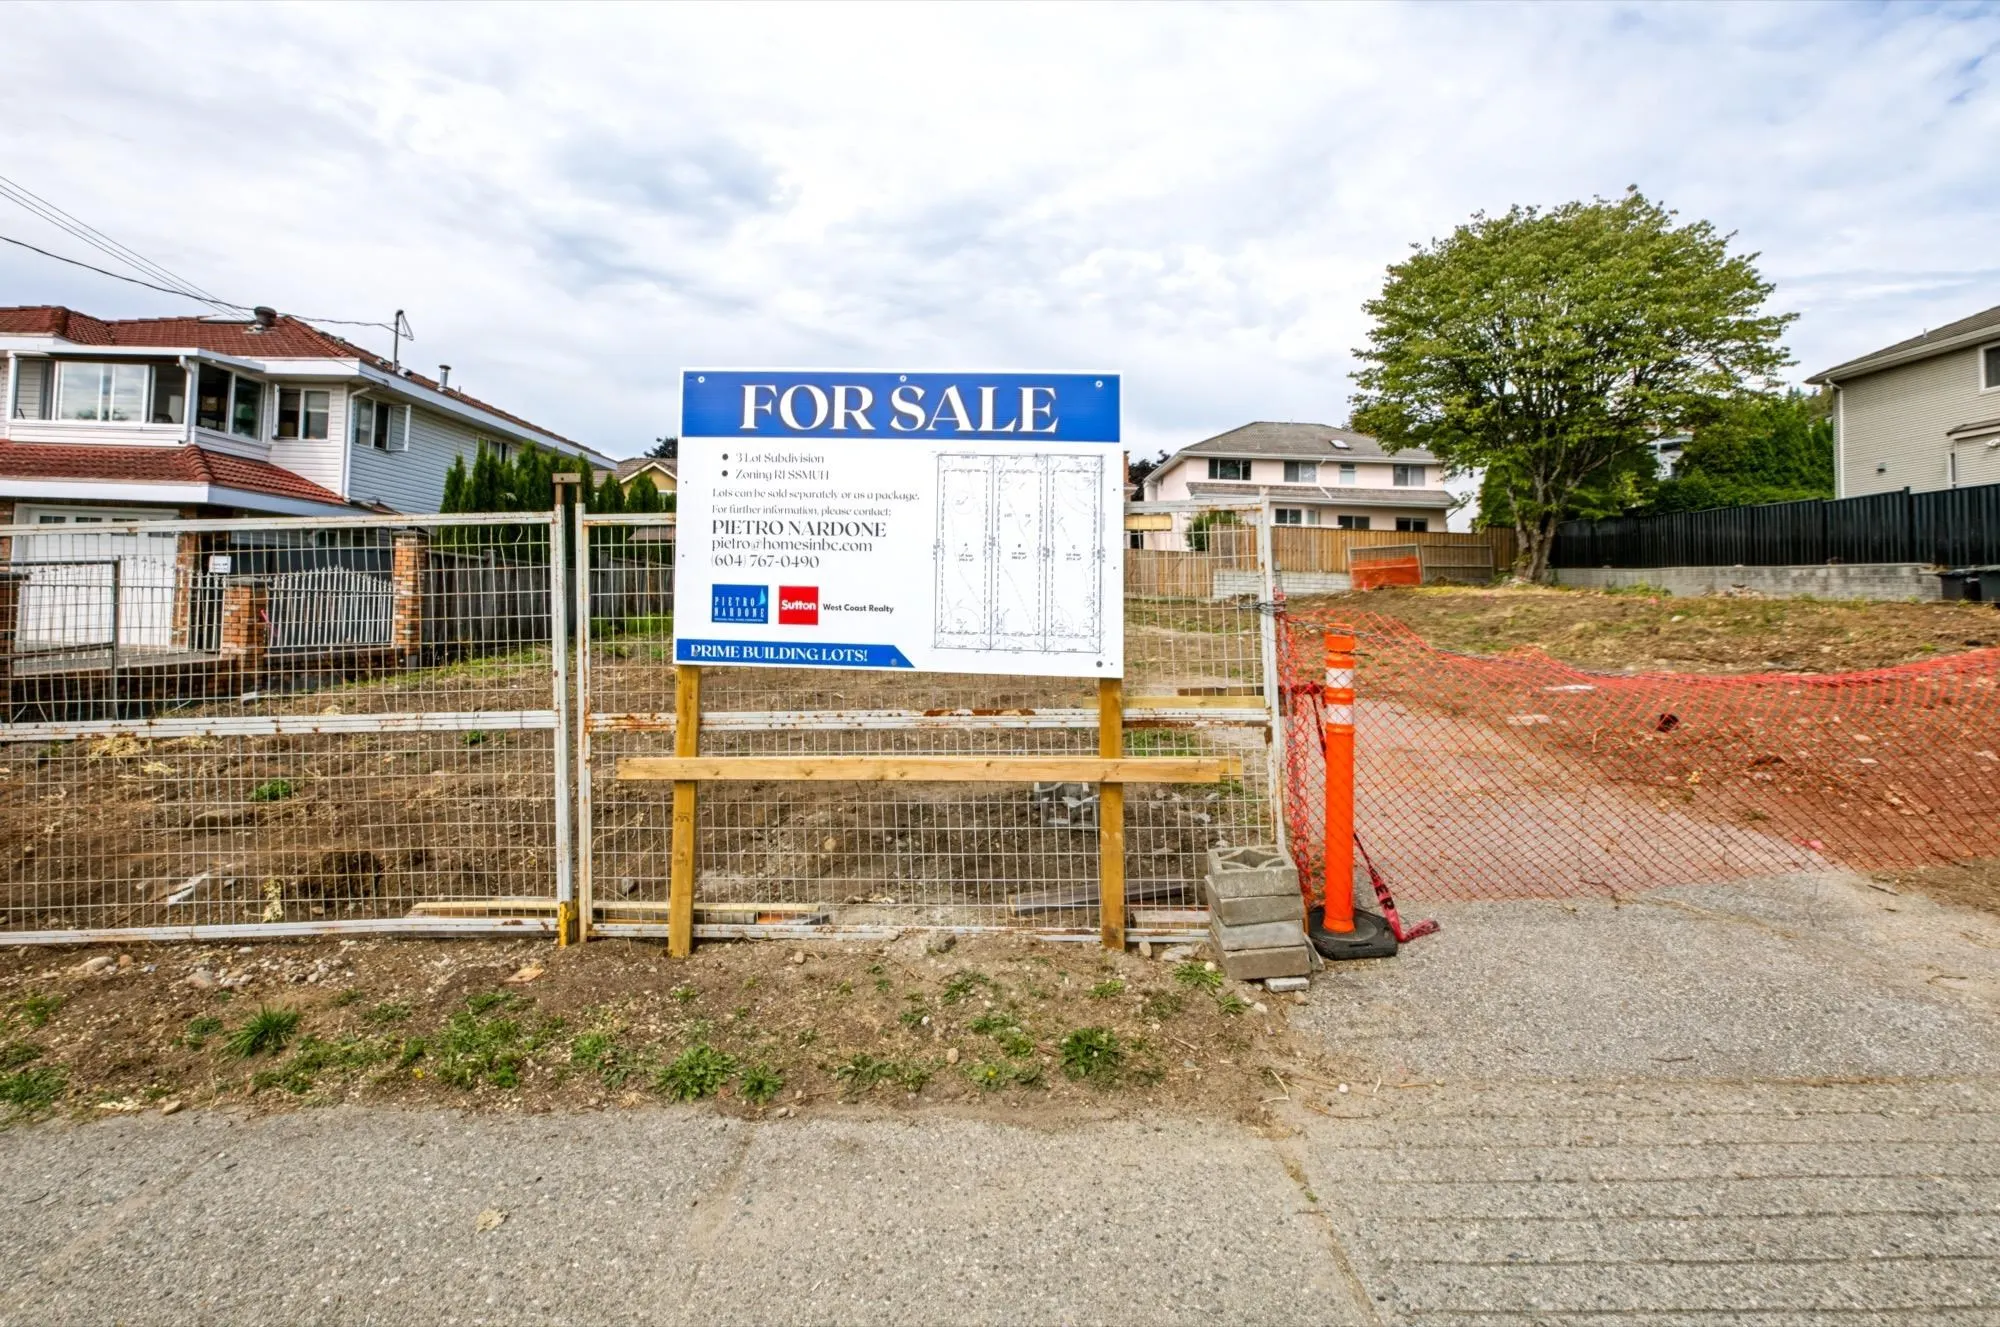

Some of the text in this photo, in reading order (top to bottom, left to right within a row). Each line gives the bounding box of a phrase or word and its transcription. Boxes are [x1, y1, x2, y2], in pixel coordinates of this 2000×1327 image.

[739, 384, 1059, 433] FOR SALE
[736, 452, 825, 464] 3 Lot Subdivision
[735, 469, 772, 482] Zoning
[787, 469, 829, 481] SSMUH
[712, 488, 920, 502] Lots can be sold separately or as a package.
[712, 504, 892, 517] For further information, please contact:
[712, 519, 887, 538] PIETRO NARDONE
[711, 537, 873, 552] pietro@homesinbc.com
[711, 554, 820, 569] (604) 767-0490
[714, 596, 755, 607] PIETRO
[781, 599, 817, 611] Sutton
[714, 606, 765, 618] NARDONE
[823, 603, 894, 614] West Coast Realty
[691, 644, 868, 662] PRIME BUILDING LOTS!
